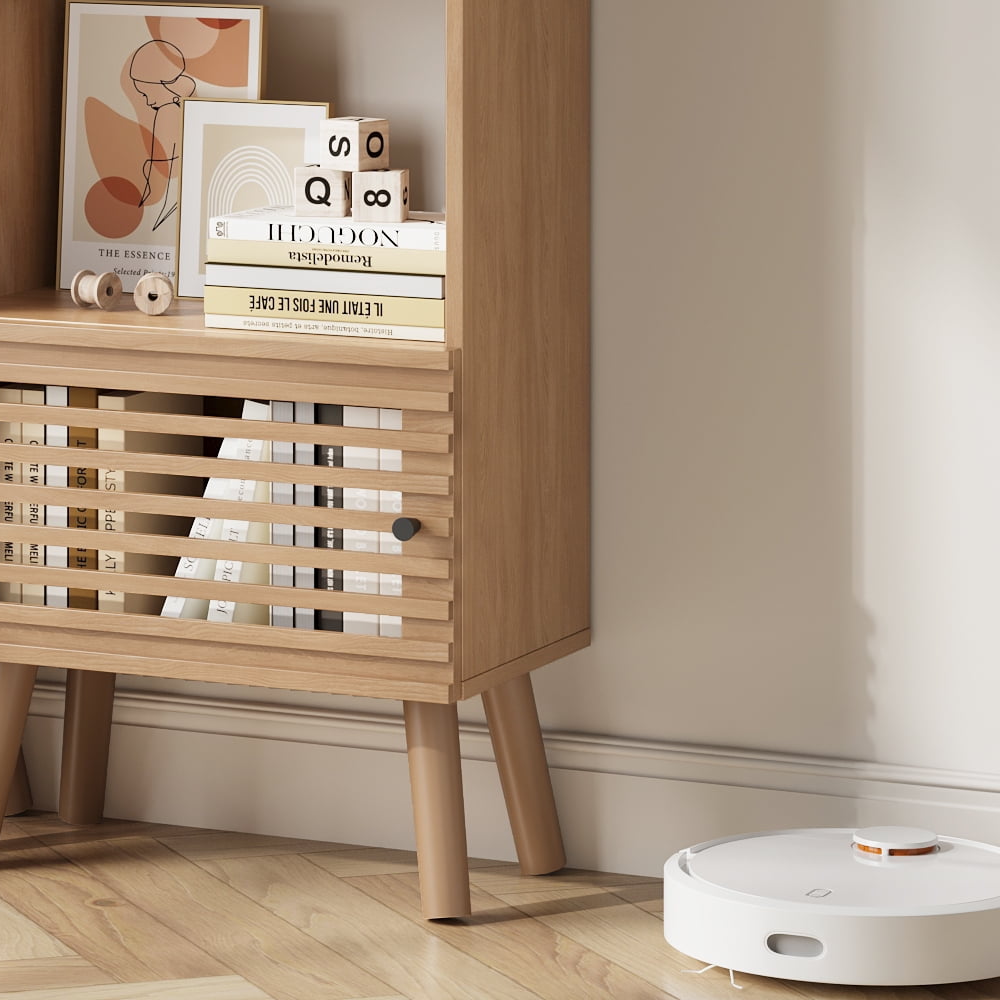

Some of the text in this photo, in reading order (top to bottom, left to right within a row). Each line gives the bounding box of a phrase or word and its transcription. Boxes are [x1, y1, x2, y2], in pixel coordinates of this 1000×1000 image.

[328, 135, 351, 157] S
[304, 176, 332, 207] Q
[363, 189, 391, 207] 8
[268, 223, 400, 248] NOGUCHI
[98, 248, 171, 261] THE ESSENCE
[288, 250, 372, 268] Remodelista
[249, 295, 383, 319] IL ÉTAIT UNE FOIS LE CAFÉ
